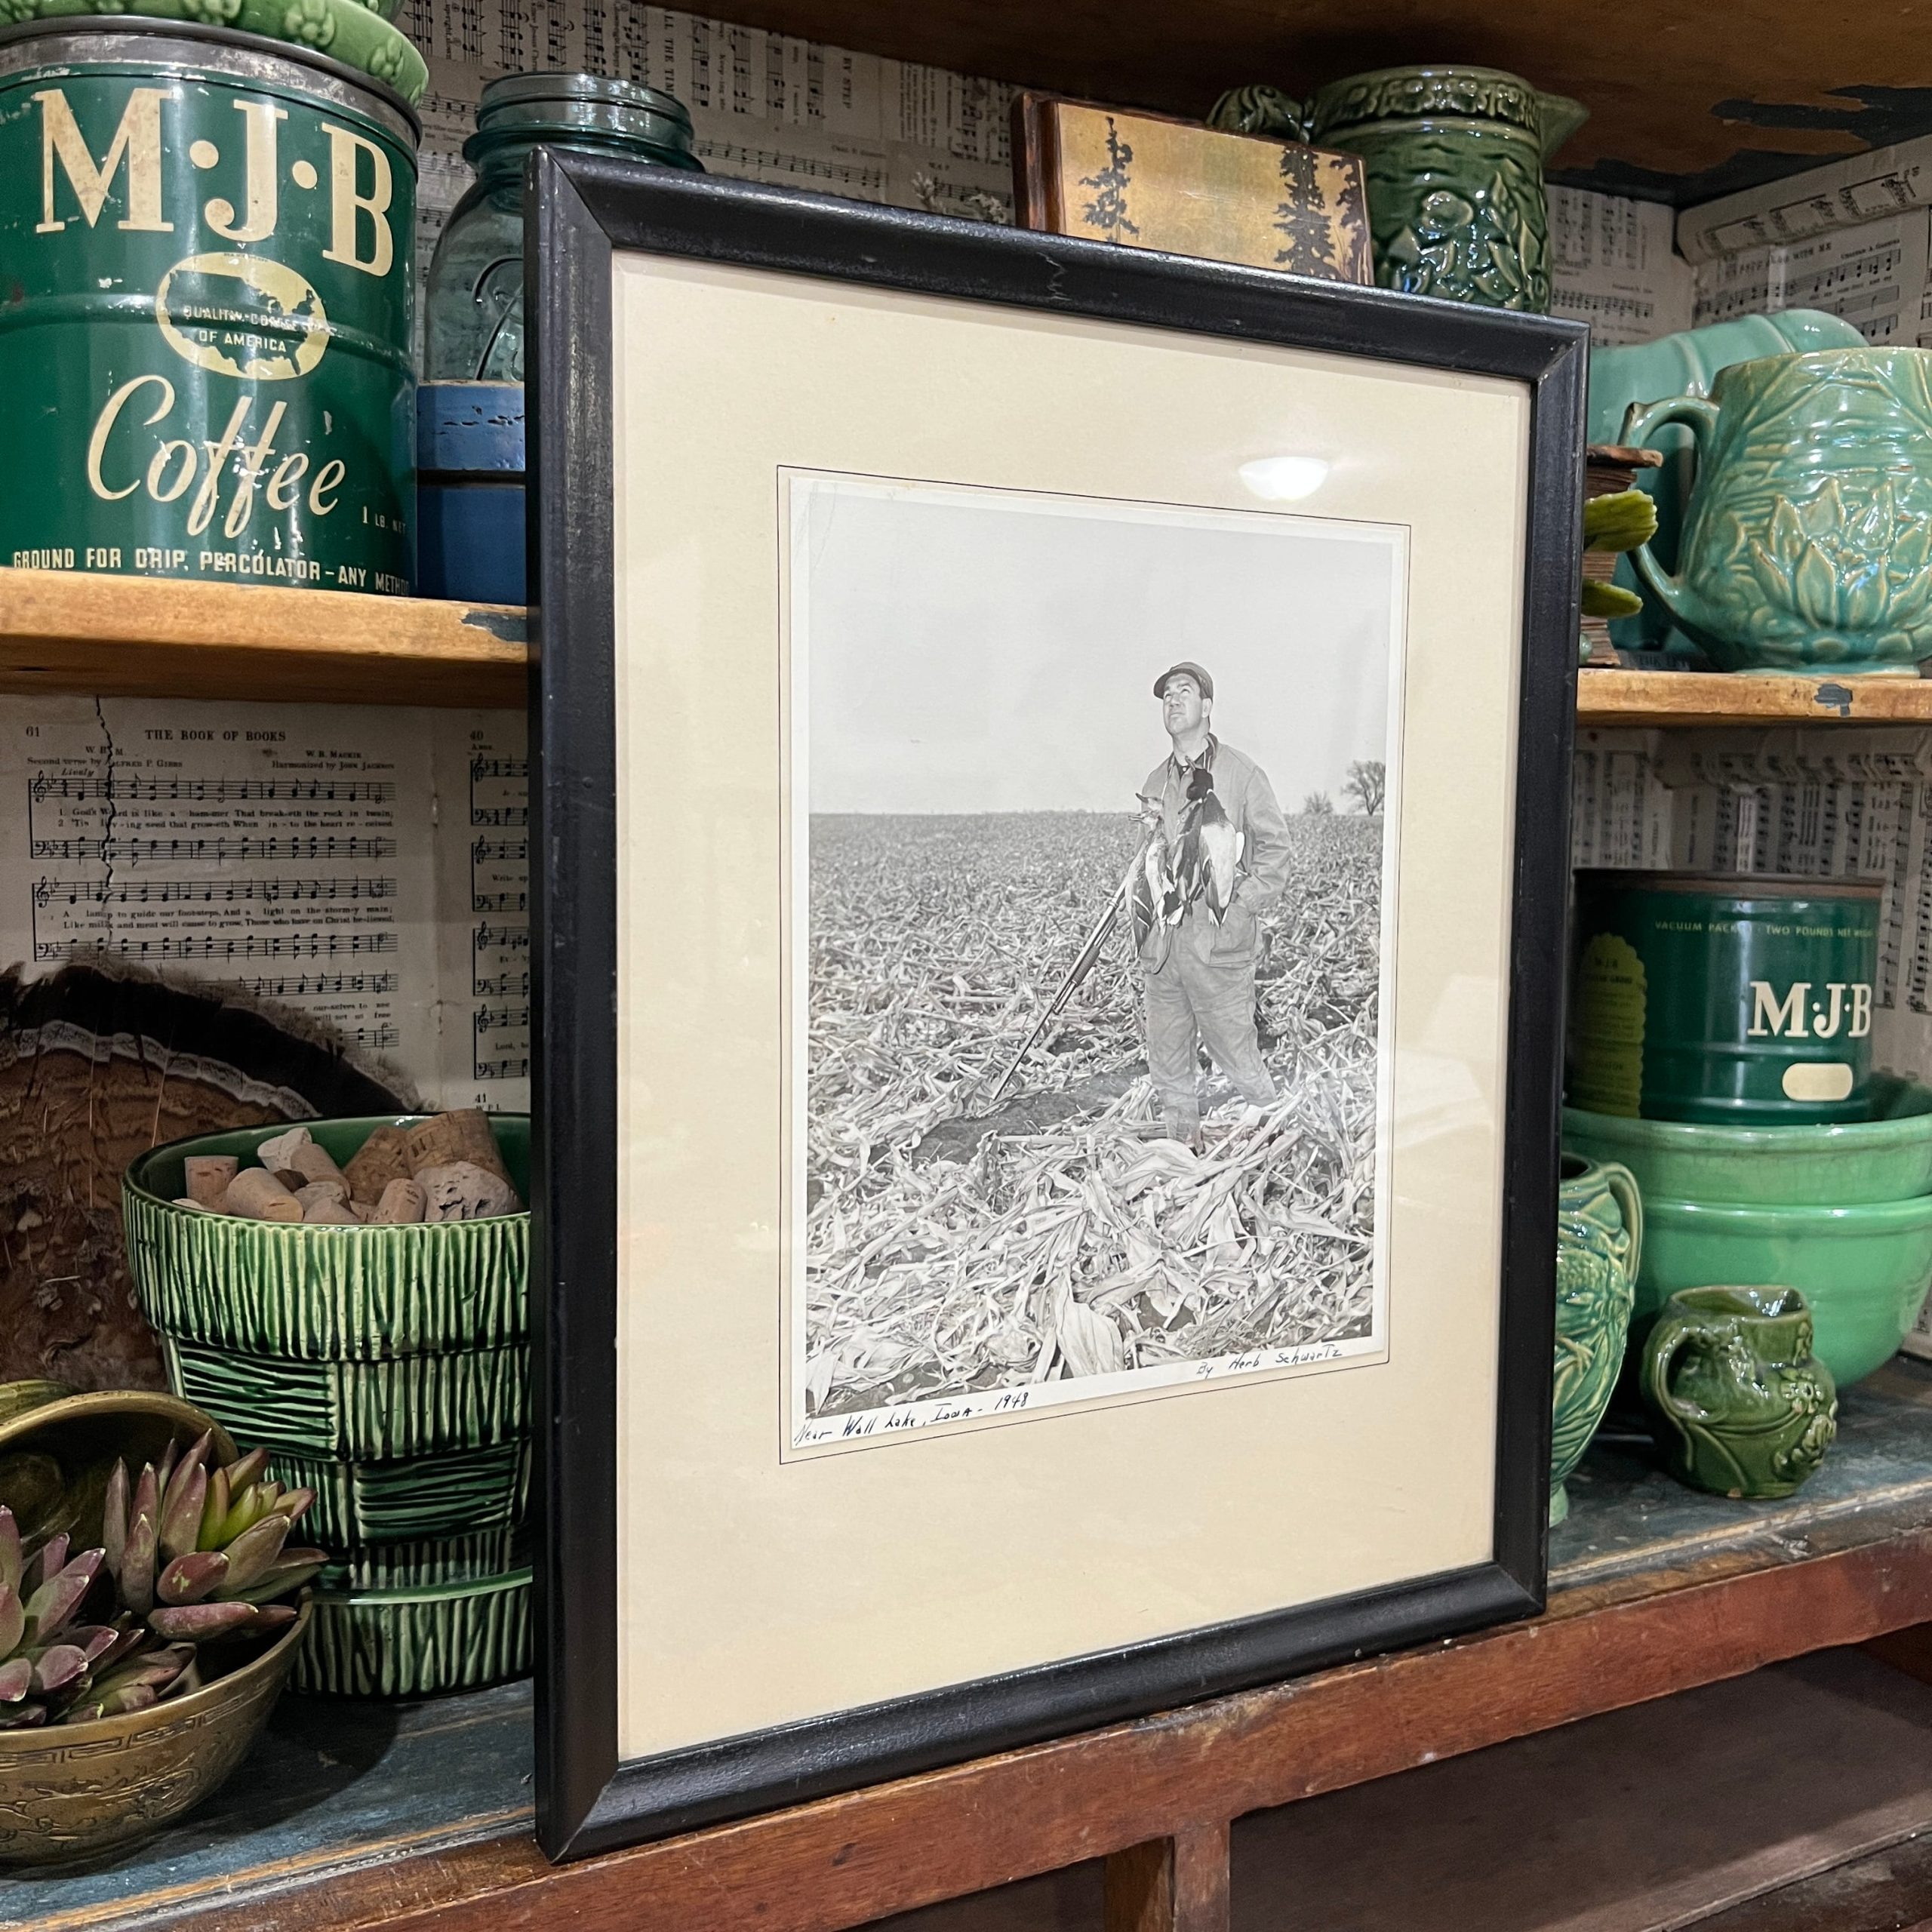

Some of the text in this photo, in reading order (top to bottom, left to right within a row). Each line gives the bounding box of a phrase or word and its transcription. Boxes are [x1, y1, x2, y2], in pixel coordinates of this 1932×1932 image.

[664, 10, 674, 30] LL
[664, 38, 675, 63] THE
[841, 77, 852, 109] STEP
[198, 330, 288, 353] OF AMERICA
[87, 374, 346, 537] Coffee
[363, 505, 368, 524] 1
[14, 548, 75, 569] GROUND
[86, 548, 122, 568] FOR
[199, 550, 320, 580] PERCOLATOR
[338, 565, 368, 588] ANY
[26, 725, 40, 737] 61
[144, 729, 286, 742] THE BOOK OF BOOKS
[469, 730, 484, 741] 40
[26, 757, 60, 765] Second
[90, 758, 102, 768] by
[271, 760, 323, 769] Harmonized
[326, 762, 337, 771] by
[61, 768, 95, 777] Lively
[144, 809, 163, 817] like
[234, 809, 255, 817] That
[323, 809, 343, 818] rock
[169, 820, 188, 829] that
[232, 820, 259, 828] When
[63, 910, 70, 918] A
[131, 910, 157, 920] guide
[223, 907, 241, 916] And
[263, 907, 284, 917] light
[63, 921, 85, 929] Like
[245, 918, 271, 926] Those
[325, 915, 350, 924] Christ
[1654, 921, 1703, 932] VACUUM
[1766, 924, 1790, 936] TWO
[1796, 925, 1834, 937] POUNDS
[475, 1093, 487, 1103] 41
[1196, 1361, 1214, 1380] By
[1228, 1352, 1262, 1370] Herb
[794, 1419, 832, 1446] Near
[994, 1392, 1029, 1411] 1948
